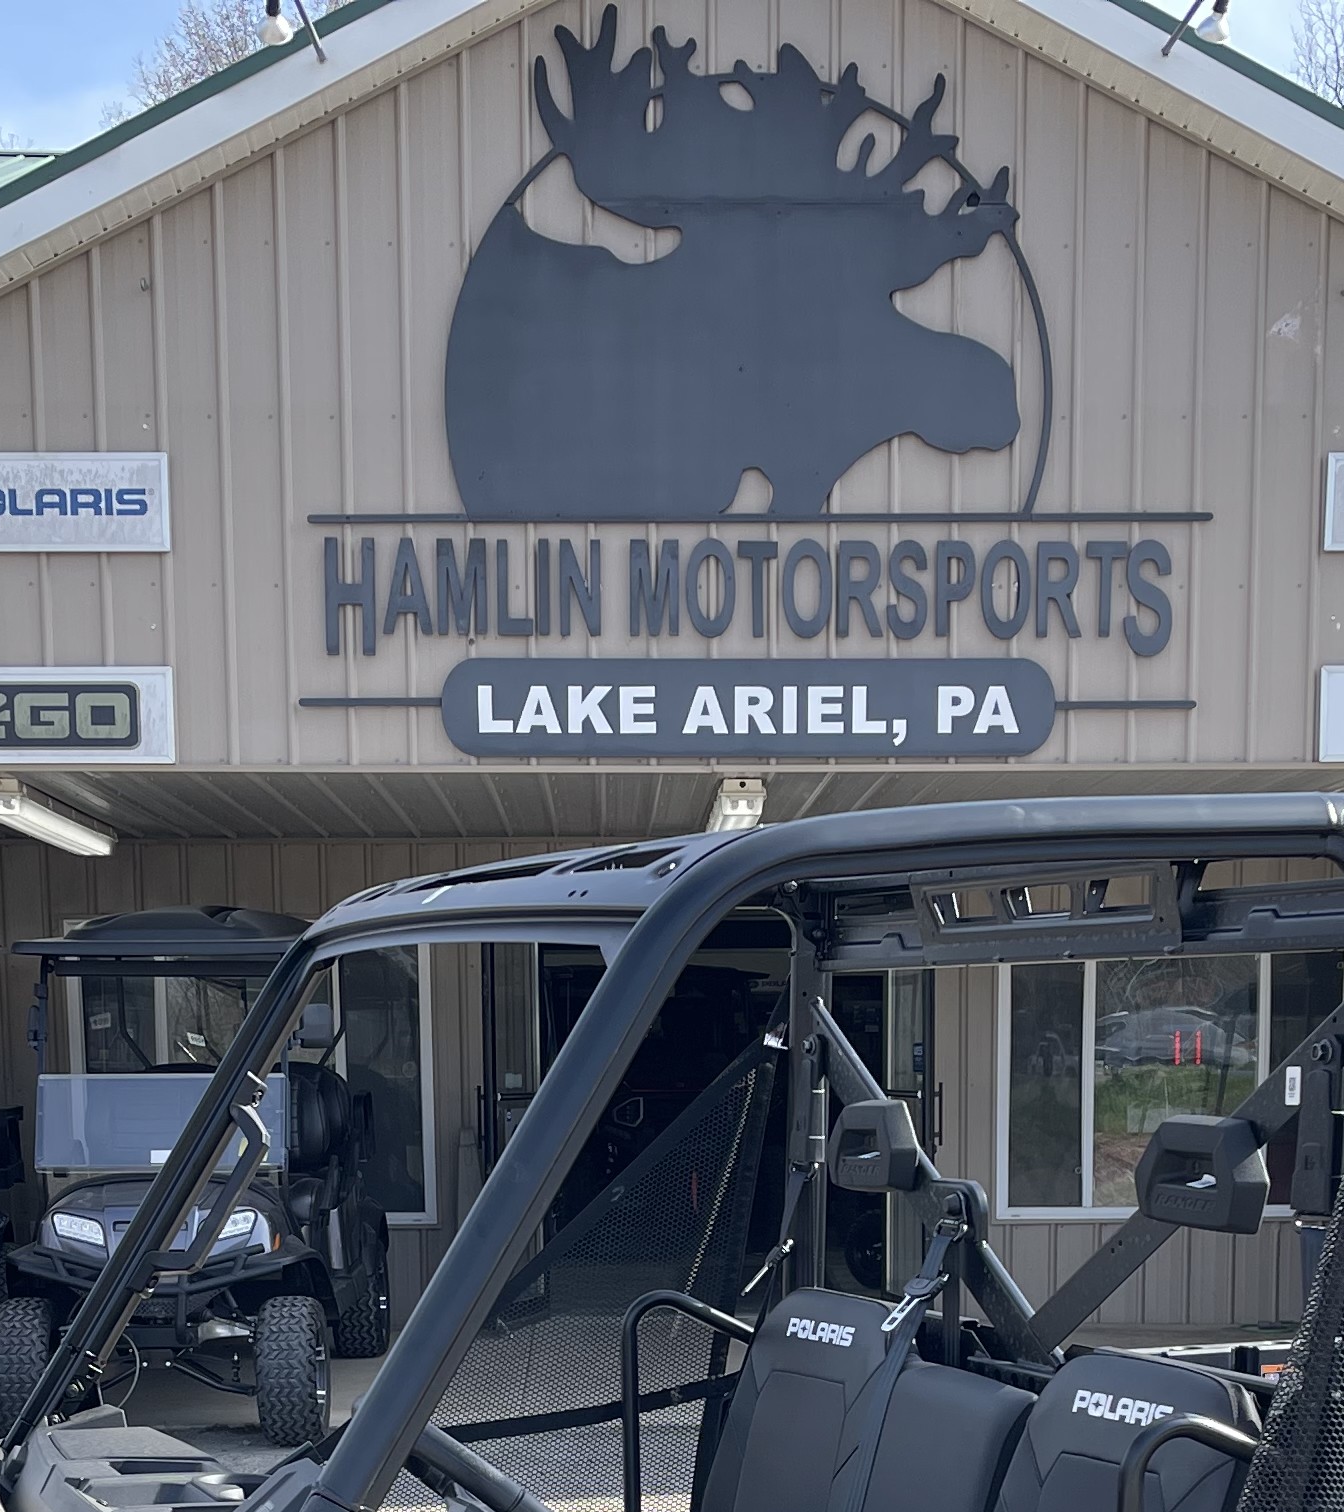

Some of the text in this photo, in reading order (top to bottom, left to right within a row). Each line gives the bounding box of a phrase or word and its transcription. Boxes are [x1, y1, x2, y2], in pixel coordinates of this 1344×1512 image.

[324, 536, 1172, 658] HAMLIN MOTORSPORTS
[477, 685, 1020, 747] LAKE ARIEL, PA
[786, 1317, 856, 1347] POLARIS
